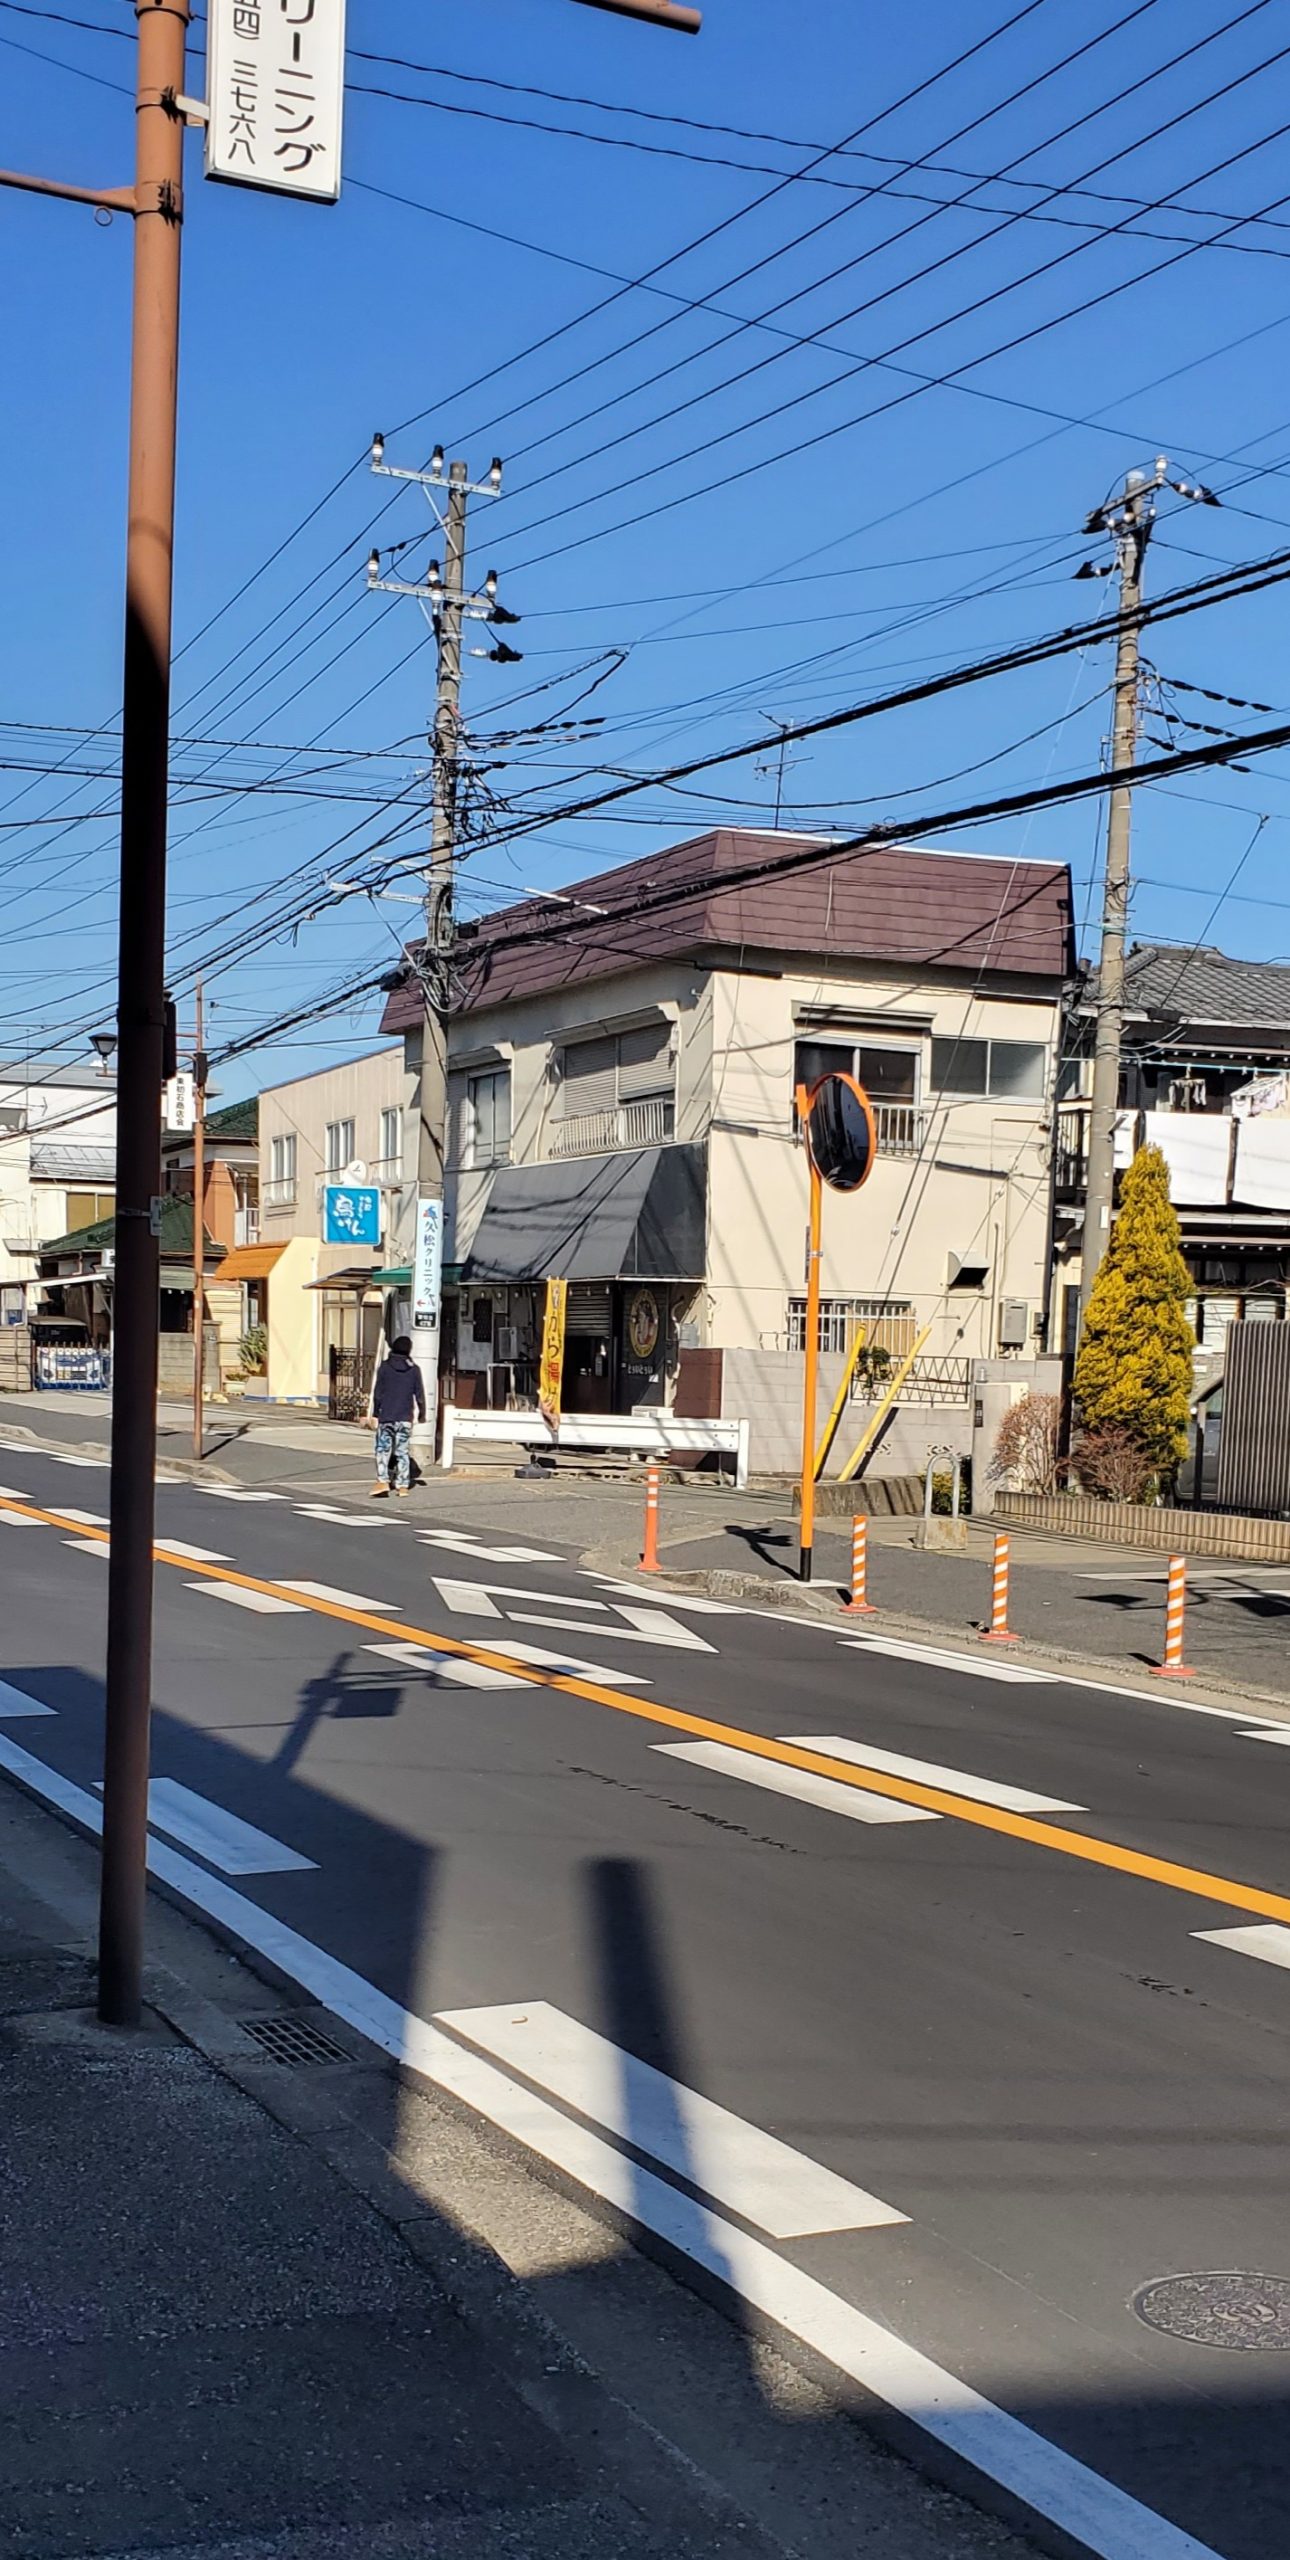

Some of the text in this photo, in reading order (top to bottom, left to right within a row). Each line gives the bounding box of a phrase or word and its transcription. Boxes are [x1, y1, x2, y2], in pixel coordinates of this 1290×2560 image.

[228, 60, 258, 165] 三七六八
[274, 0, 327, 172] リーニング
[423, 1220, 436, 1296] 久松クリニック
